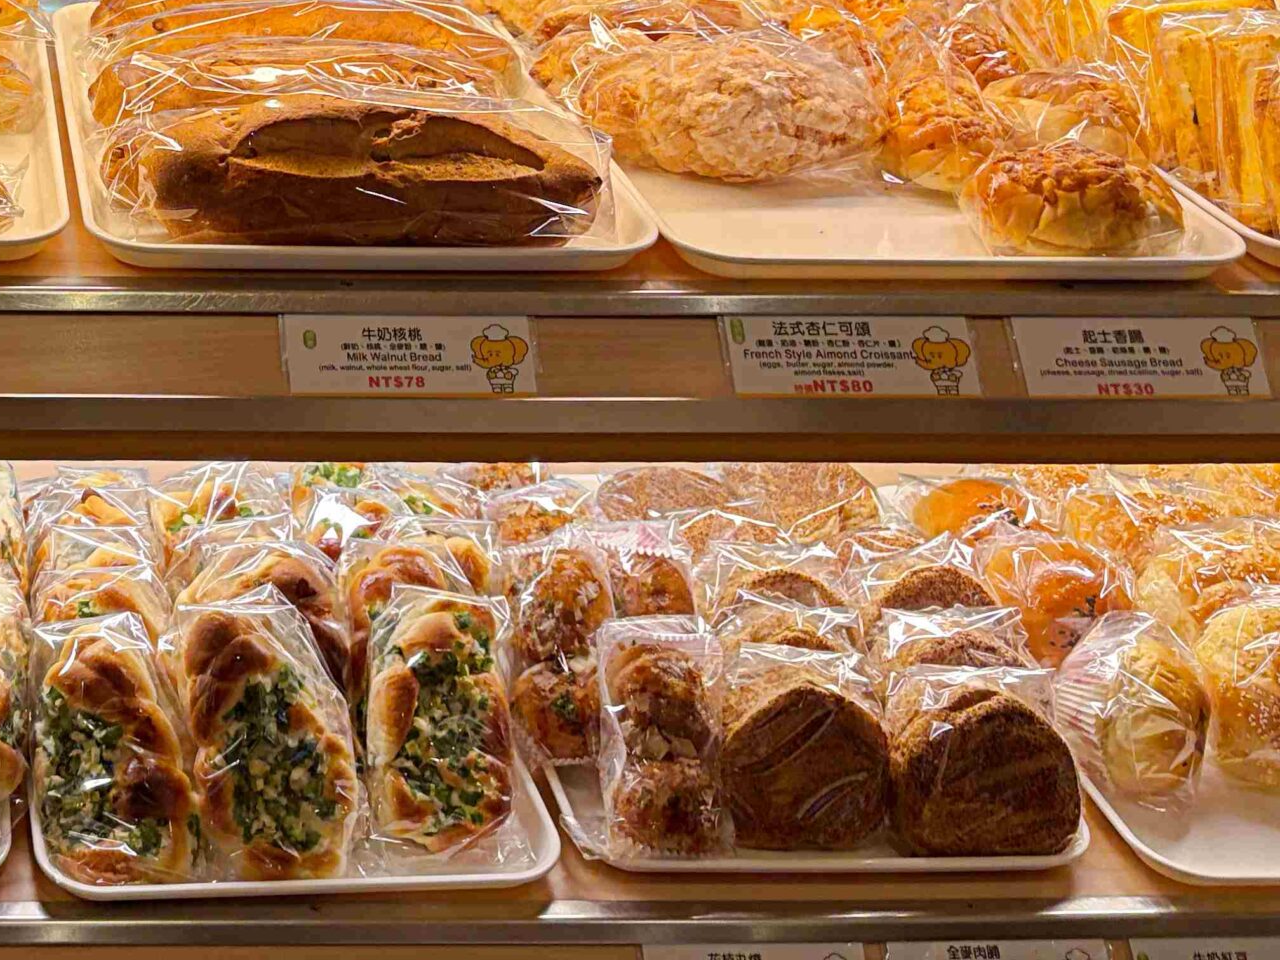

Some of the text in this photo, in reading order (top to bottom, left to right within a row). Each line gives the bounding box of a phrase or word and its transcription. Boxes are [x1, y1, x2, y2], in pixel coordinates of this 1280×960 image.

[362, 327, 422, 341] 牛奶核桃
[772, 321, 871, 336] 法式杏仁可頌
[347, 352, 442, 361] Milk Walnut Bread
[743, 349, 916, 361] French Style Almond Croissant
[1055, 358, 1183, 368] Cheese Sausage Bread
[368, 376, 425, 388] NT$78
[1097, 384, 1154, 395] NT$30
